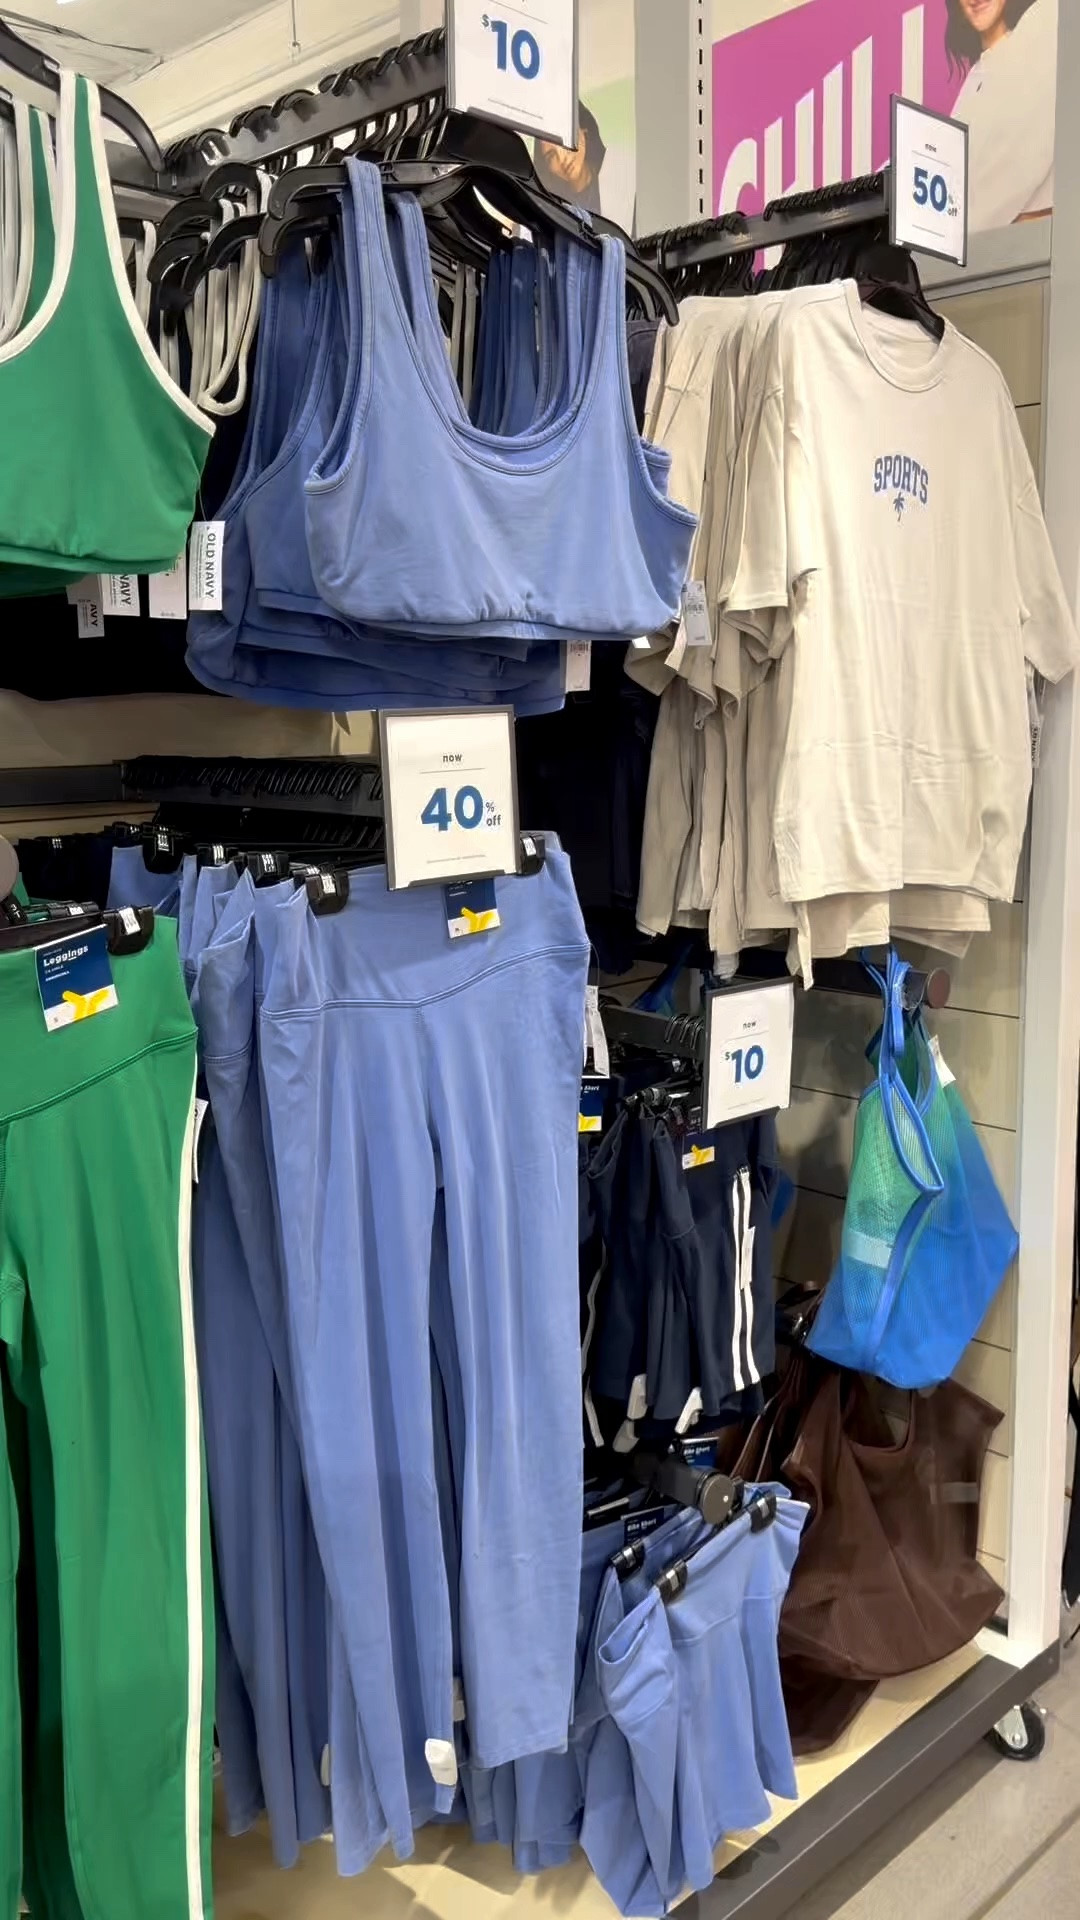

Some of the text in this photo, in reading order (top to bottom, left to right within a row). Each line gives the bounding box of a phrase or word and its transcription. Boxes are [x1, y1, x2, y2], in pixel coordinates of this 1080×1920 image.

[481, 14, 540, 80] $10
[874, 454, 928, 505] SPORTS
[205, 533, 216, 598] OLD NAVY
[90, 604, 98, 627] AVY
[442, 753, 462, 763] now
[486, 814, 501, 826] off
[43, 945, 89, 967] Leggings
[743, 1021, 756, 1030] now
[725, 1045, 764, 1084] $10
